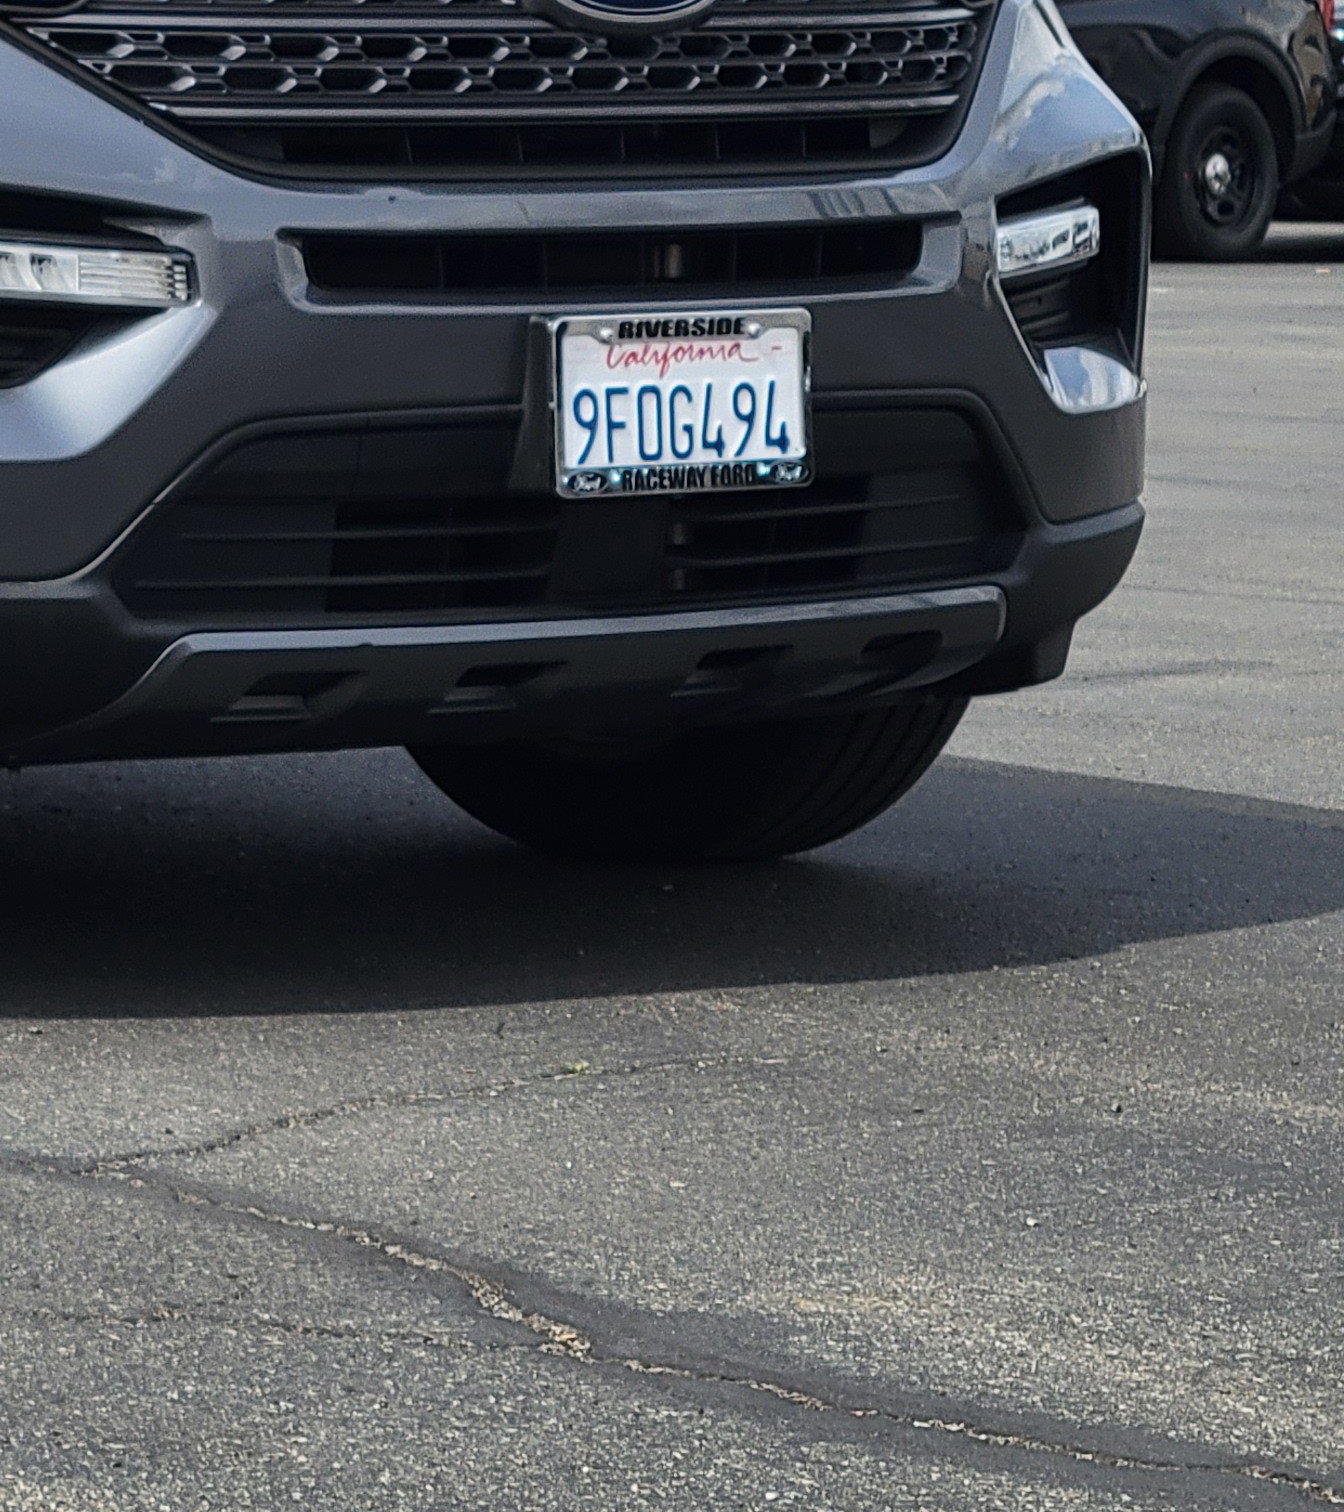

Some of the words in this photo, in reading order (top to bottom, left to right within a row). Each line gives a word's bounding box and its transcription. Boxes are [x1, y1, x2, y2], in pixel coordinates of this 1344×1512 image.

[618, 317, 745, 339] RIVERSIDE
[606, 341, 760, 379] California
[622, 465, 708, 491] RACEWAY
[713, 464, 757, 487] FORD
